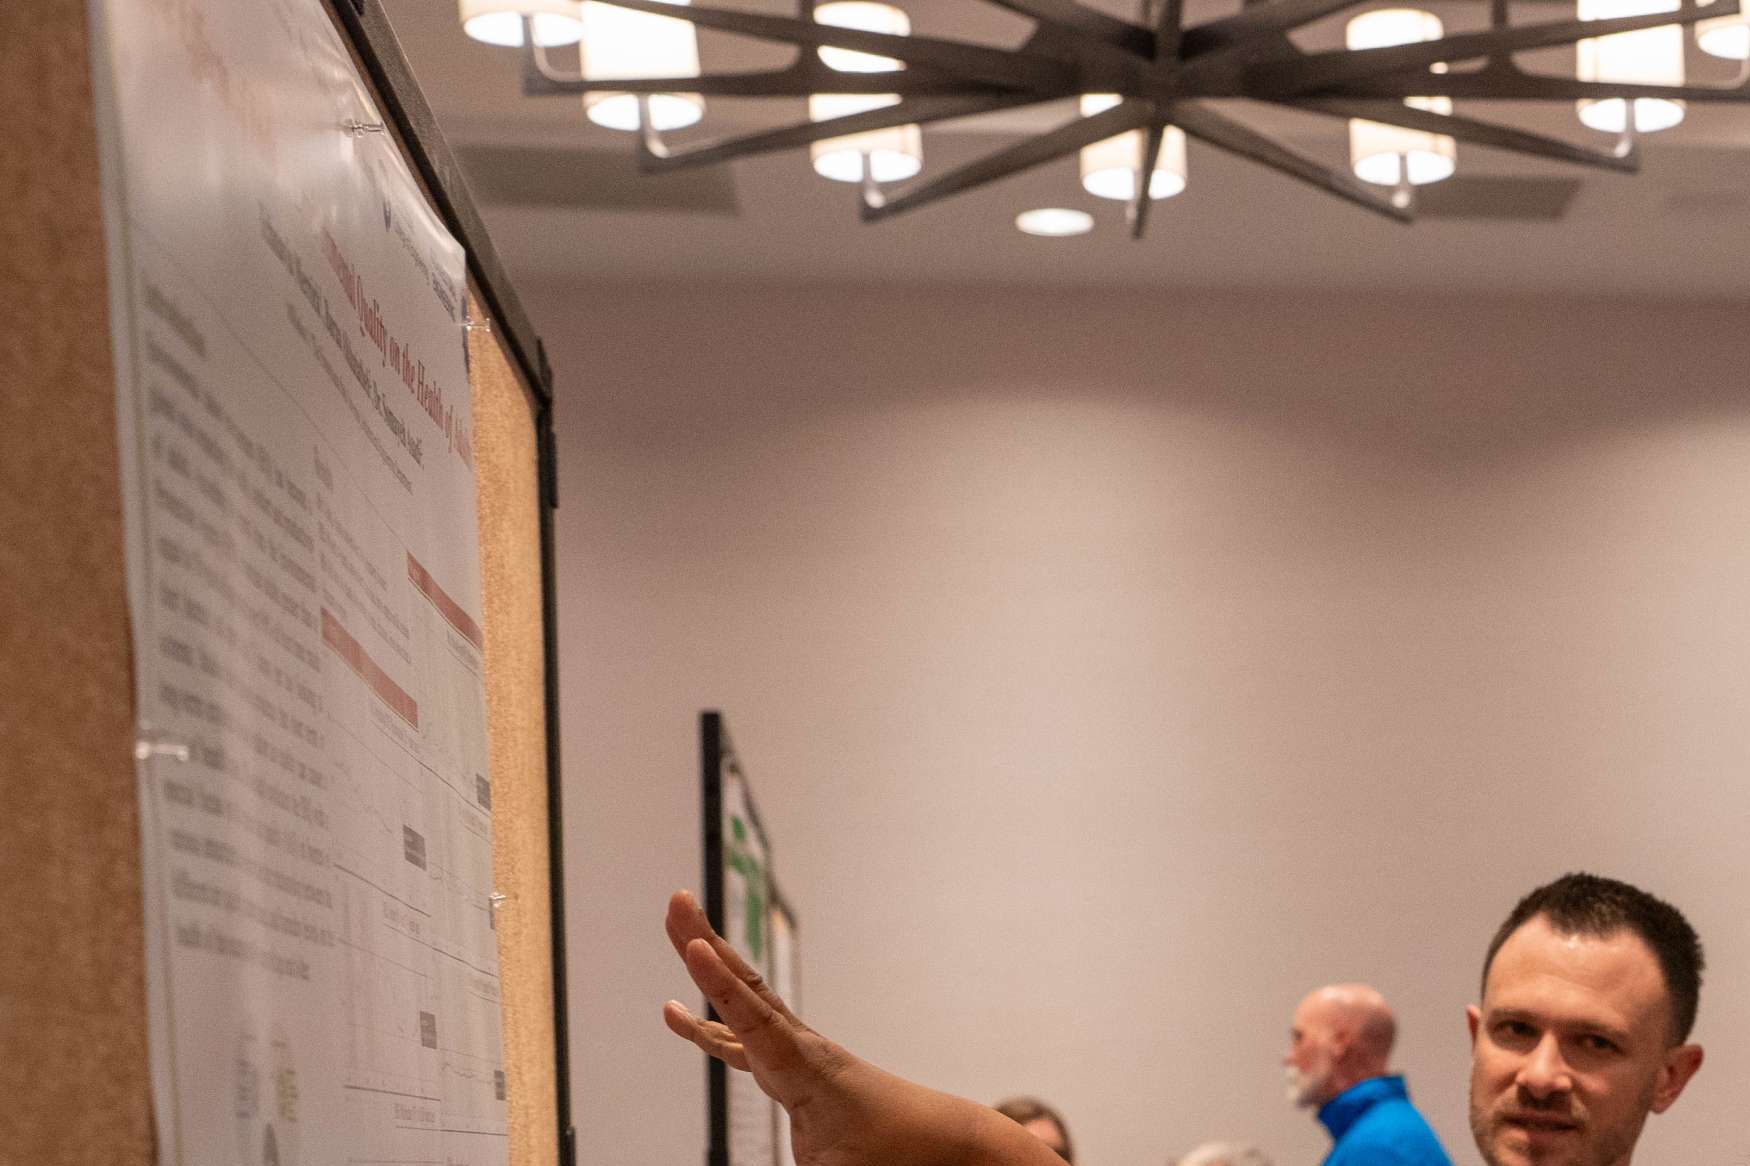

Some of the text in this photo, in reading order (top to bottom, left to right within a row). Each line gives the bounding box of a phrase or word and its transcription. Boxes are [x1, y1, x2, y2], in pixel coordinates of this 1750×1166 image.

[357, 274, 387, 368] Quality
[390, 336, 400, 376] on
[402, 343, 415, 394] the
[417, 359, 443, 432] Health
